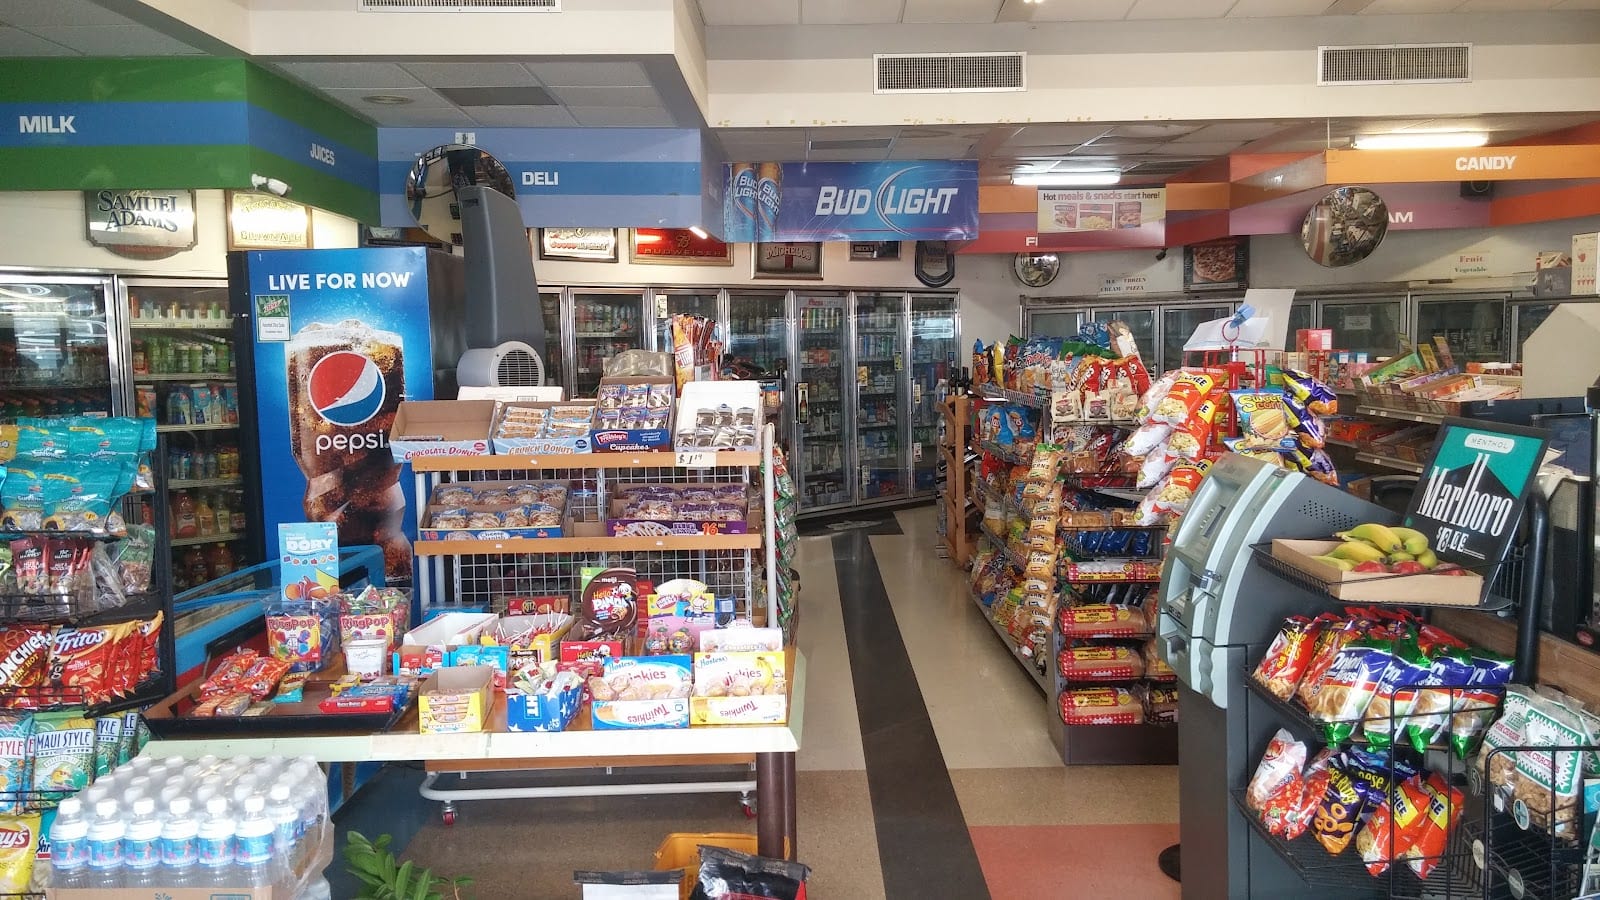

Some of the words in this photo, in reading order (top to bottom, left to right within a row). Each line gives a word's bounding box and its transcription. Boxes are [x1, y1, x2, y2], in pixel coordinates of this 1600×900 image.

[19, 115, 76, 133] MILK
[310, 143, 335, 166] JUICES
[1455, 155, 1517, 171] CANDY
[521, 171, 559, 186] DELI
[739, 175, 757, 189] BUD
[98, 190, 178, 213] SAMUEL
[762, 183, 780, 205] BUD
[815, 186, 871, 215] BUD
[882, 187, 958, 214] LIGHT
[1043, 193, 1056, 201] Hot
[1057, 192, 1084, 201] meals
[1085, 192, 1092, 200] &
[1093, 190, 1122, 200] snacks
[1124, 192, 1140, 200] start
[1142, 191, 1160, 199] here!
[105, 211, 178, 232] ADAMS
[1459, 255, 1484, 263] Fruit
[269, 274, 311, 291] LIVE
[316, 272, 356, 290] FOR
[362, 271, 411, 288] NOW
[315, 428, 386, 456] pepsi
[507, 446, 540, 455] CRUNCH
[543, 443, 575, 454] DONUTS
[609, 442, 650, 451] Cupcakes
[1470, 437, 1509, 450] MENTHOL
[404, 447, 447, 461] CHOCOLATE
[449, 446, 481, 456] DONUTS
[1416, 452, 1513, 537] Marlboro
[702, 522, 718, 535] 16
[285, 538, 334, 551] DORY
[601, 576, 618, 584] meiji
[593, 589, 611, 599] Hello
[592, 597, 627, 611] PANDA
[54, 630, 105, 654] Fritos
[576, 651, 592, 659] Hello
[699, 656, 726, 668] Hostess
[608, 660, 635, 672] Hostess
[627, 702, 671, 724] Twinkies
[719, 700, 759, 717] Twinkies
[37, 732, 61, 750] MAUI
[62, 730, 92, 748] STYLE
